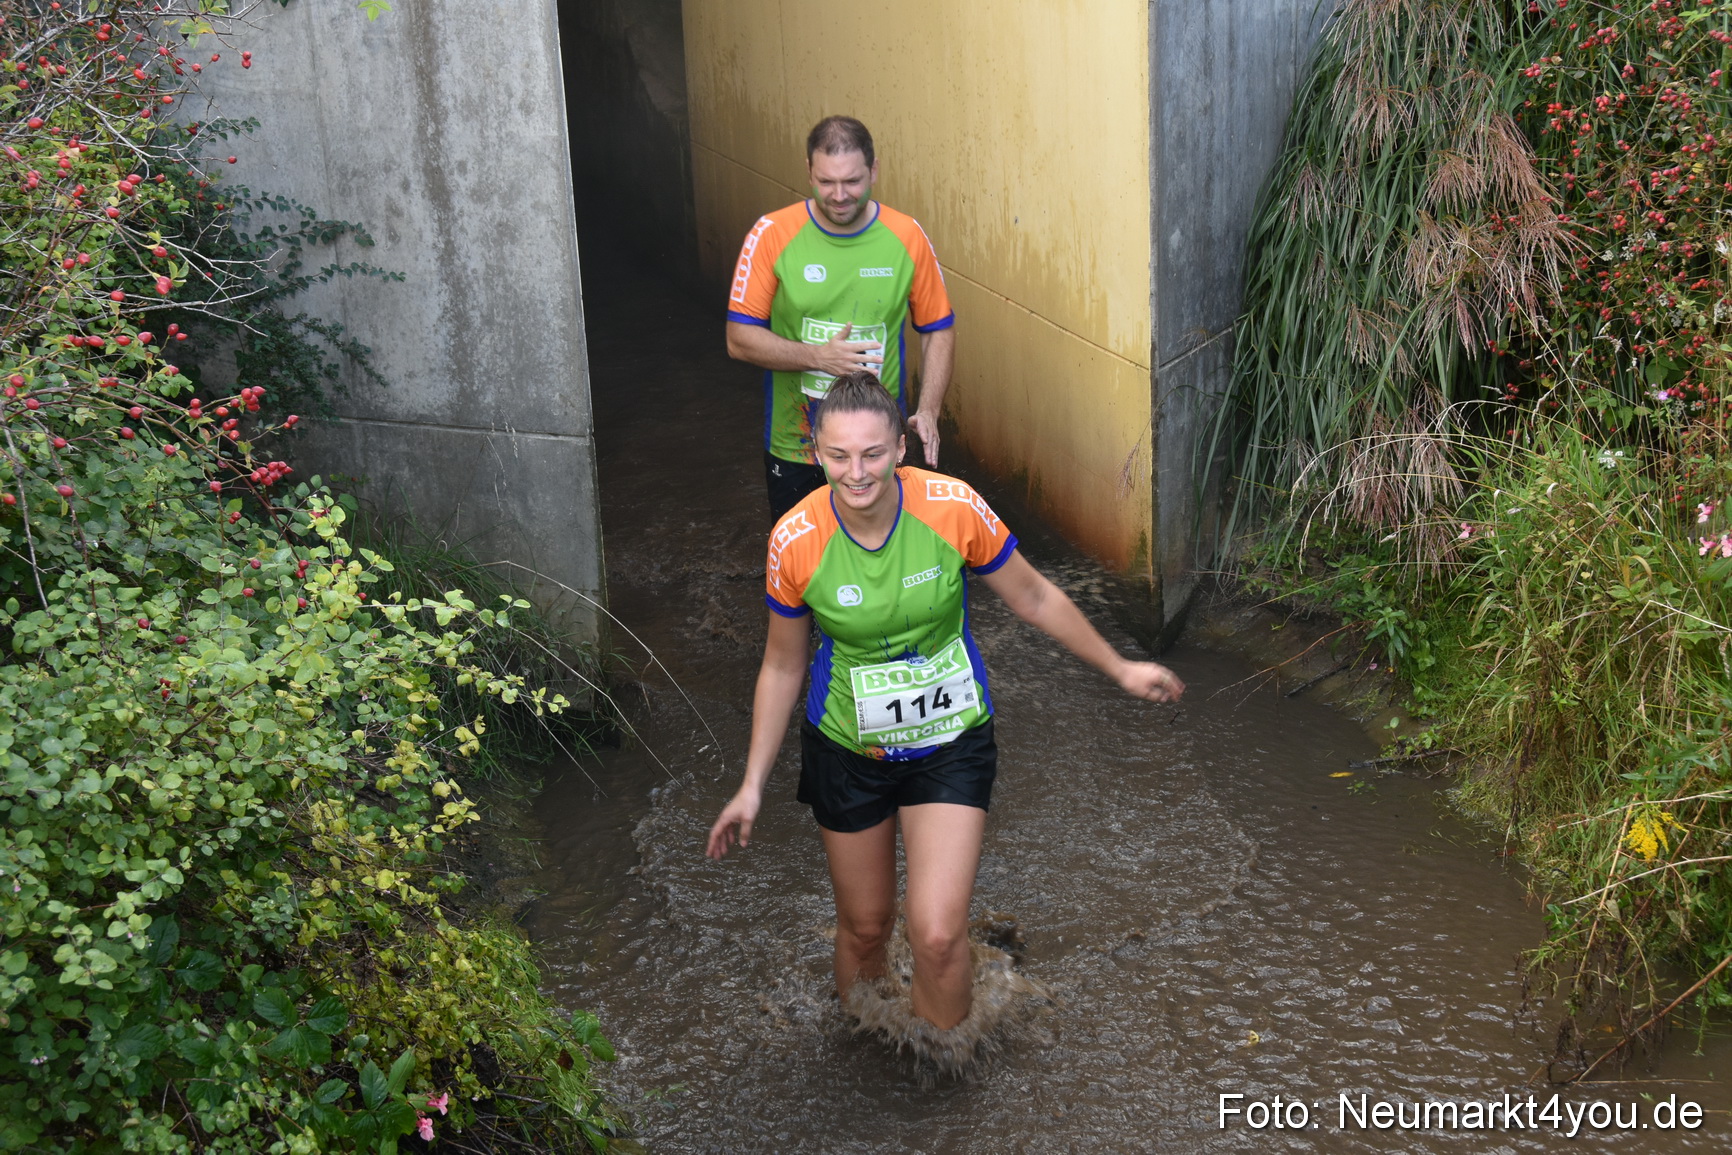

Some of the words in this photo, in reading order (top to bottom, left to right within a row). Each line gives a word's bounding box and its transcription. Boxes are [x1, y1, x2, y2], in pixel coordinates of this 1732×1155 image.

[730, 216, 774, 303] BOCK
[859, 267, 894, 277] BOCK
[926, 479, 1000, 536] BOCK
[902, 565, 943, 588] BOCK
[861, 649, 961, 694] BOCK
[885, 686, 952, 724] 114
[877, 715, 965, 744] VIKTORIA
